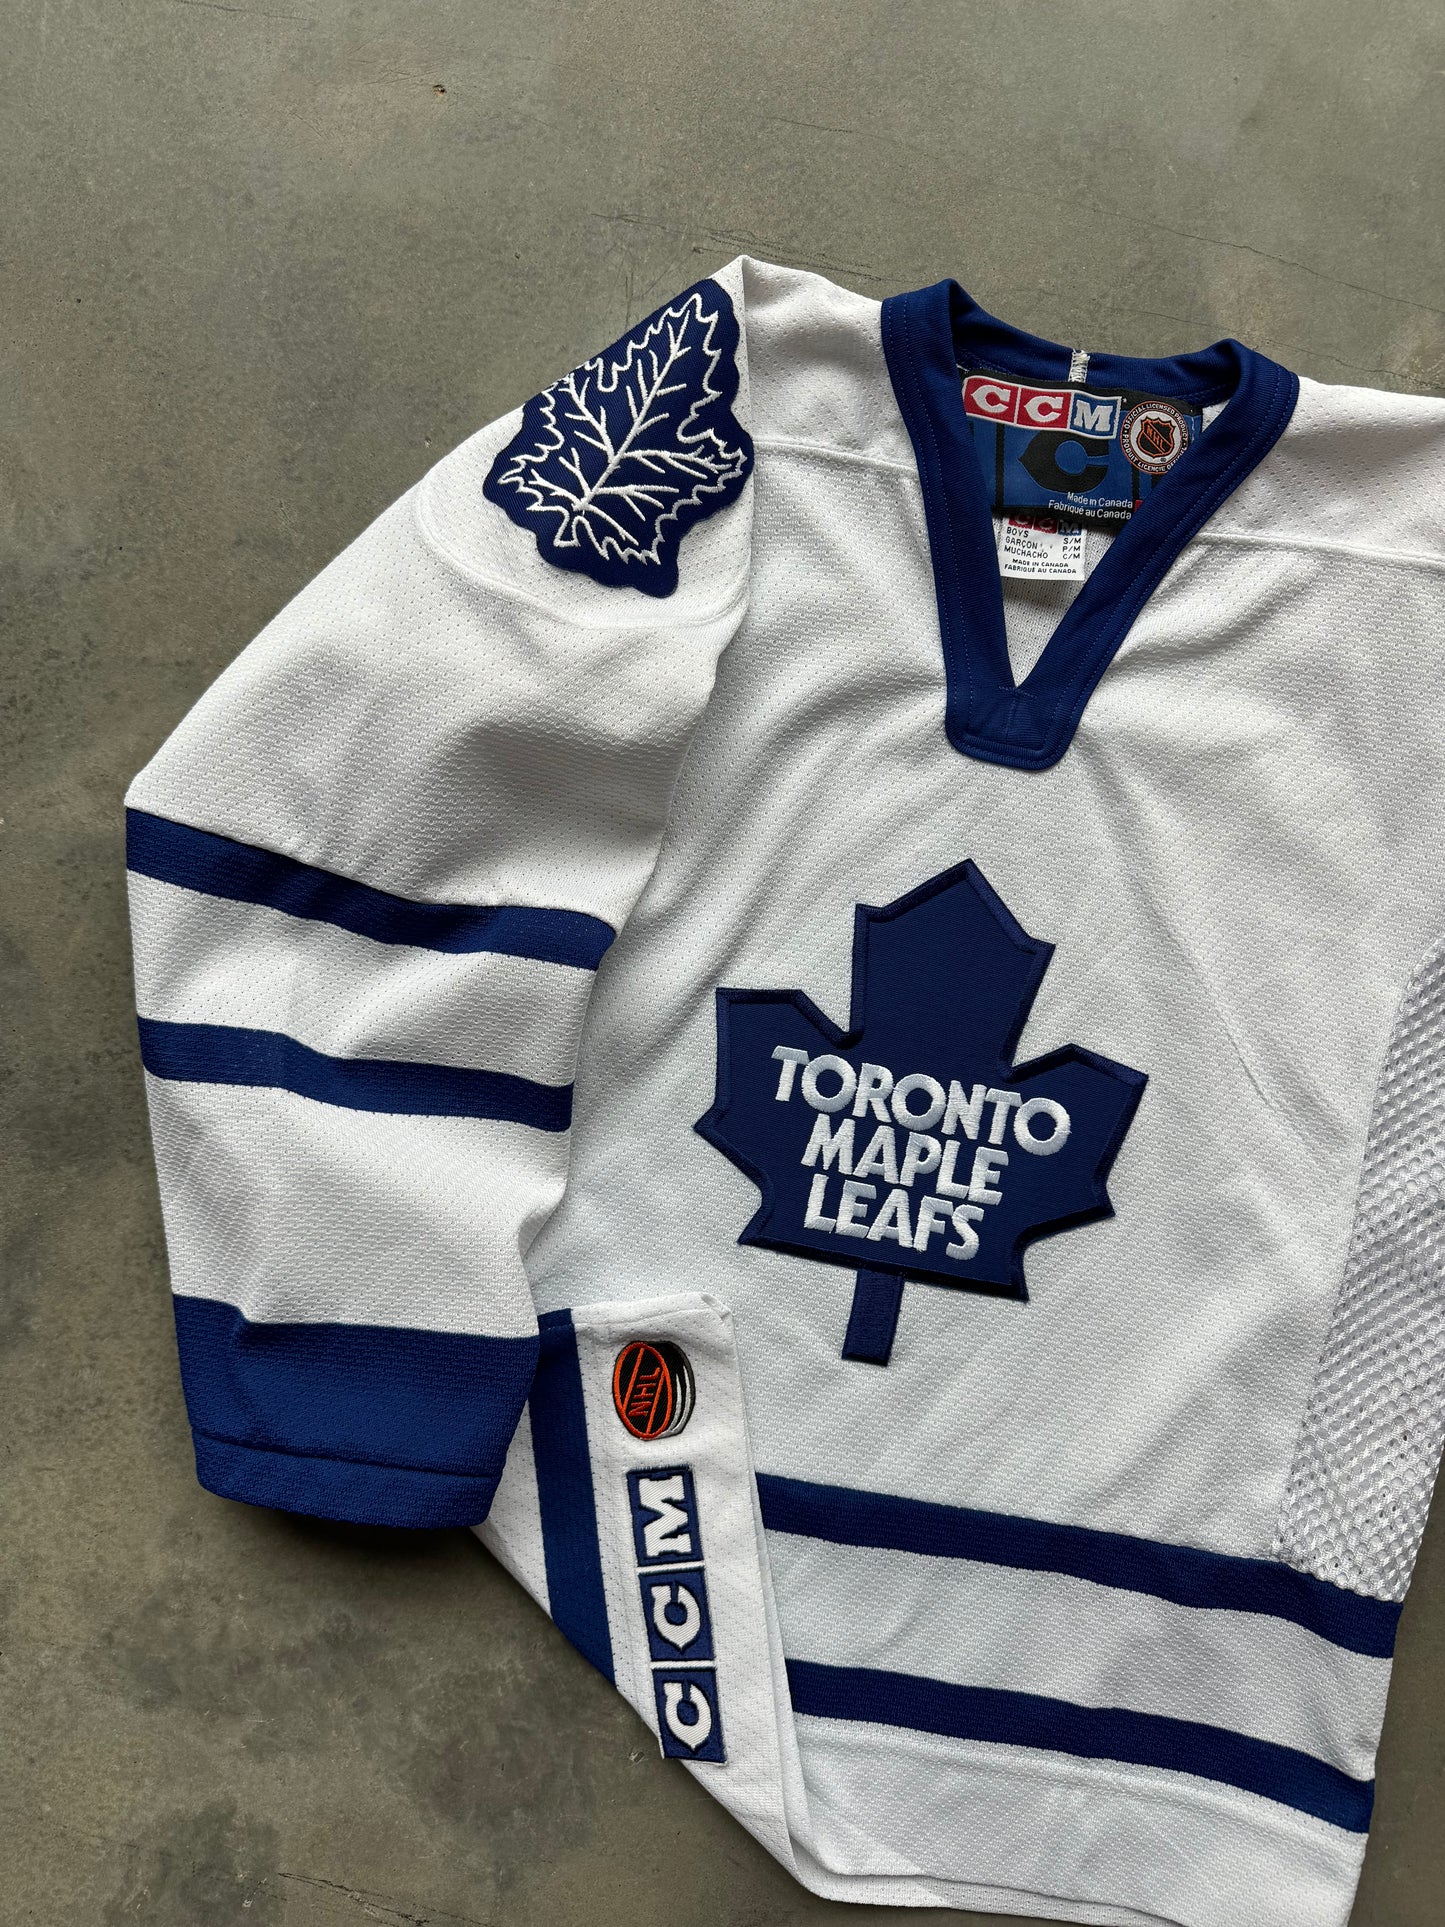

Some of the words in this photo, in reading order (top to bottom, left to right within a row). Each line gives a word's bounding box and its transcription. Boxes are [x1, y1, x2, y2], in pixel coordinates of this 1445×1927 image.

[970, 384, 1114, 432] CCM
[1124, 405, 1145, 430] OFFICIAL
[1146, 403, 1175, 415] LICENSED
[1174, 413, 1188, 440] PRODUCT
[1123, 434, 1138, 463] PRODUIT
[1146, 425, 1166, 452] NHL
[1048, 500, 1084, 516] Fabriqué
[1085, 509, 1096, 518] au
[1097, 508, 1132, 520] Canada
[1067, 491, 1089, 505] Made
[1089, 498, 1097, 506] in
[1098, 498, 1133, 509] Canada
[1005, 536, 1038, 550] GARÇON
[1006, 527, 1029, 538] BOYS
[1063, 537, 1081, 545] S/M
[1004, 545, 1049, 559] MUCHACHO
[1012, 558, 1030, 566] MADE
[771, 1045, 1072, 1156] TORONTO
[801, 1114, 1009, 1206] MAPLE
[804, 1174, 985, 1261] LEAFS
[628, 1367, 660, 1416] NHL
[638, 1474, 713, 1752] CCM
